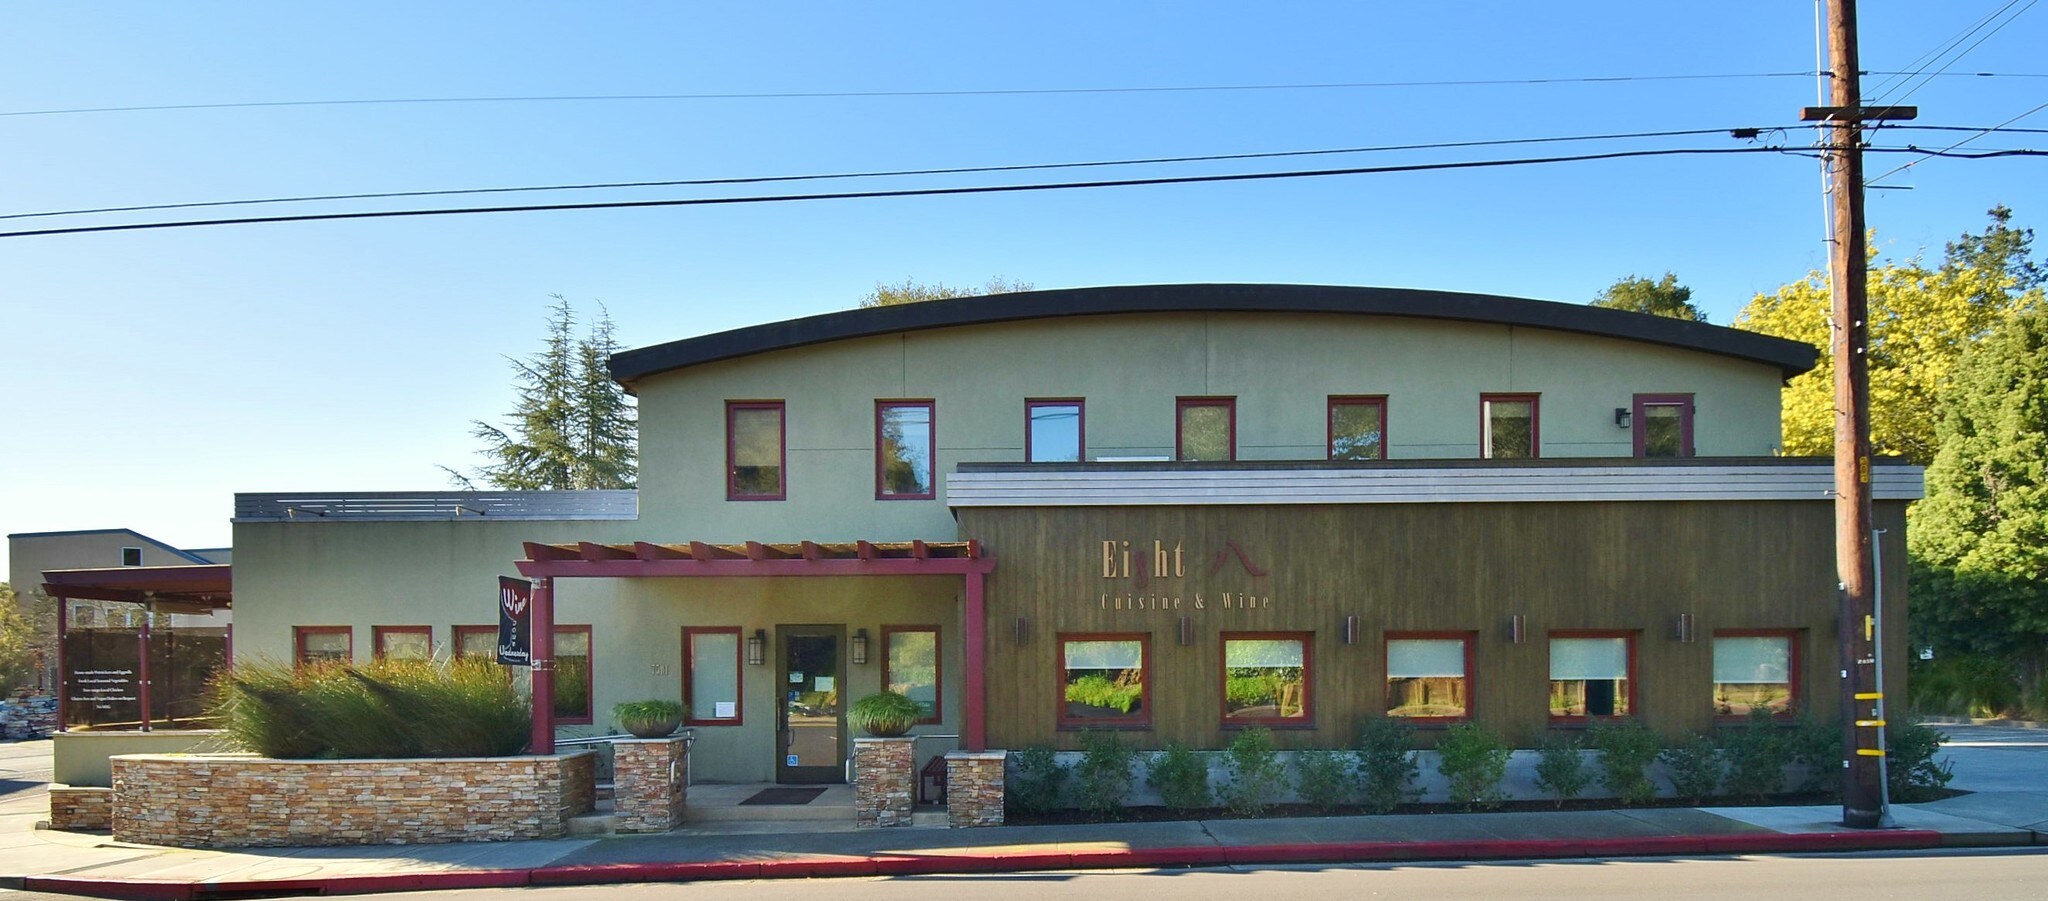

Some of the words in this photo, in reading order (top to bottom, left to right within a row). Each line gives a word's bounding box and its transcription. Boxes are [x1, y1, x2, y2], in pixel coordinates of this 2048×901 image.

[1102, 539, 1185, 588] Eight
[1101, 593, 1181, 610] Cuisine
[1194, 592, 1205, 609] &
[1222, 592, 1269, 609] Wine
